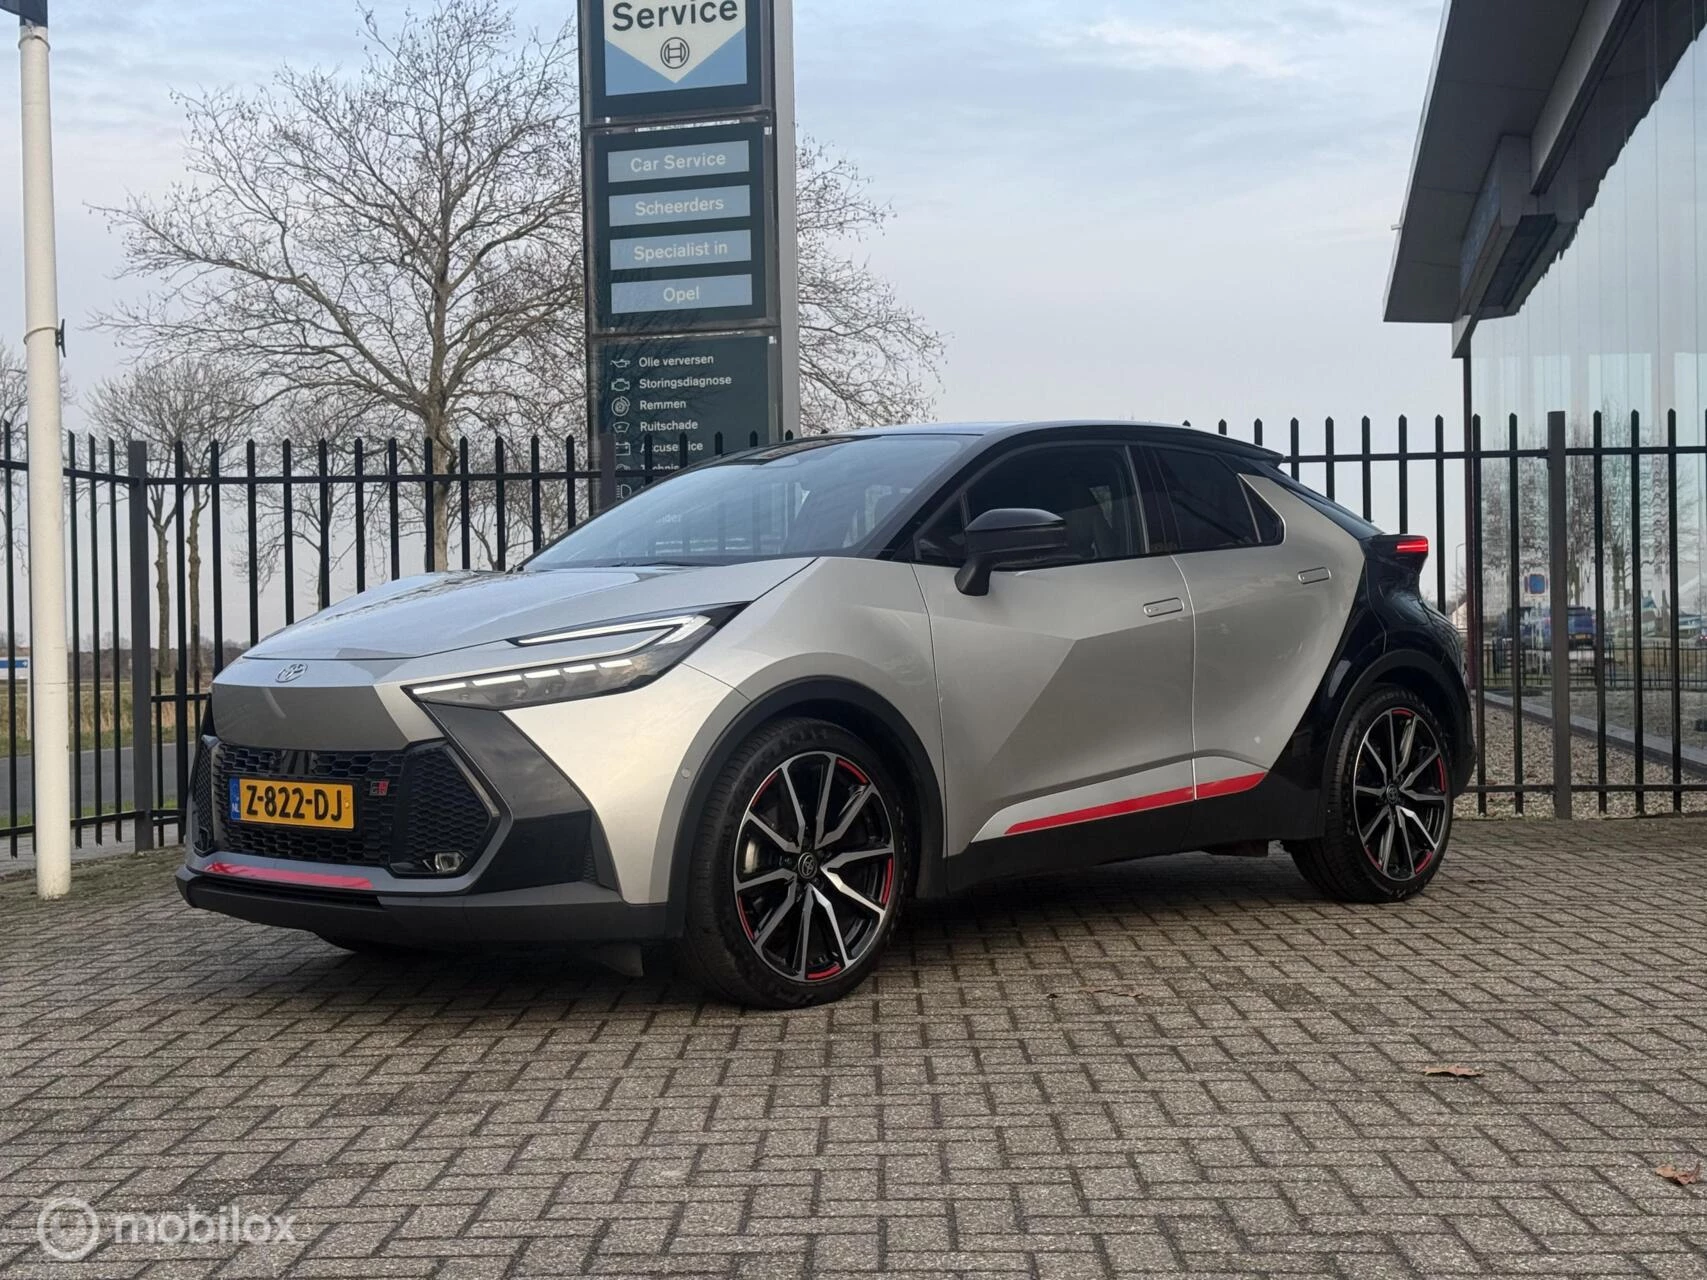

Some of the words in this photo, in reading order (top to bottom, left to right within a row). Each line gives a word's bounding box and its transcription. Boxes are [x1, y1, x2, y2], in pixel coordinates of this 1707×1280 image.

[612, 0, 738, 31] Service
[630, 157, 659, 173] Car
[663, 153, 727, 169] Service
[634, 197, 725, 217] Scheerders
[633, 242, 710, 262] Specialist
[714, 241, 728, 255] in
[663, 286, 700, 303] Opel
[638, 356, 660, 368] Olie
[662, 355, 714, 366] verversen
[639, 375, 732, 390] Storingsdiagnose
[639, 400, 687, 411] Remmen
[640, 419, 699, 432] Ruitschade
[246, 784, 343, 822] Z-822-DJ
